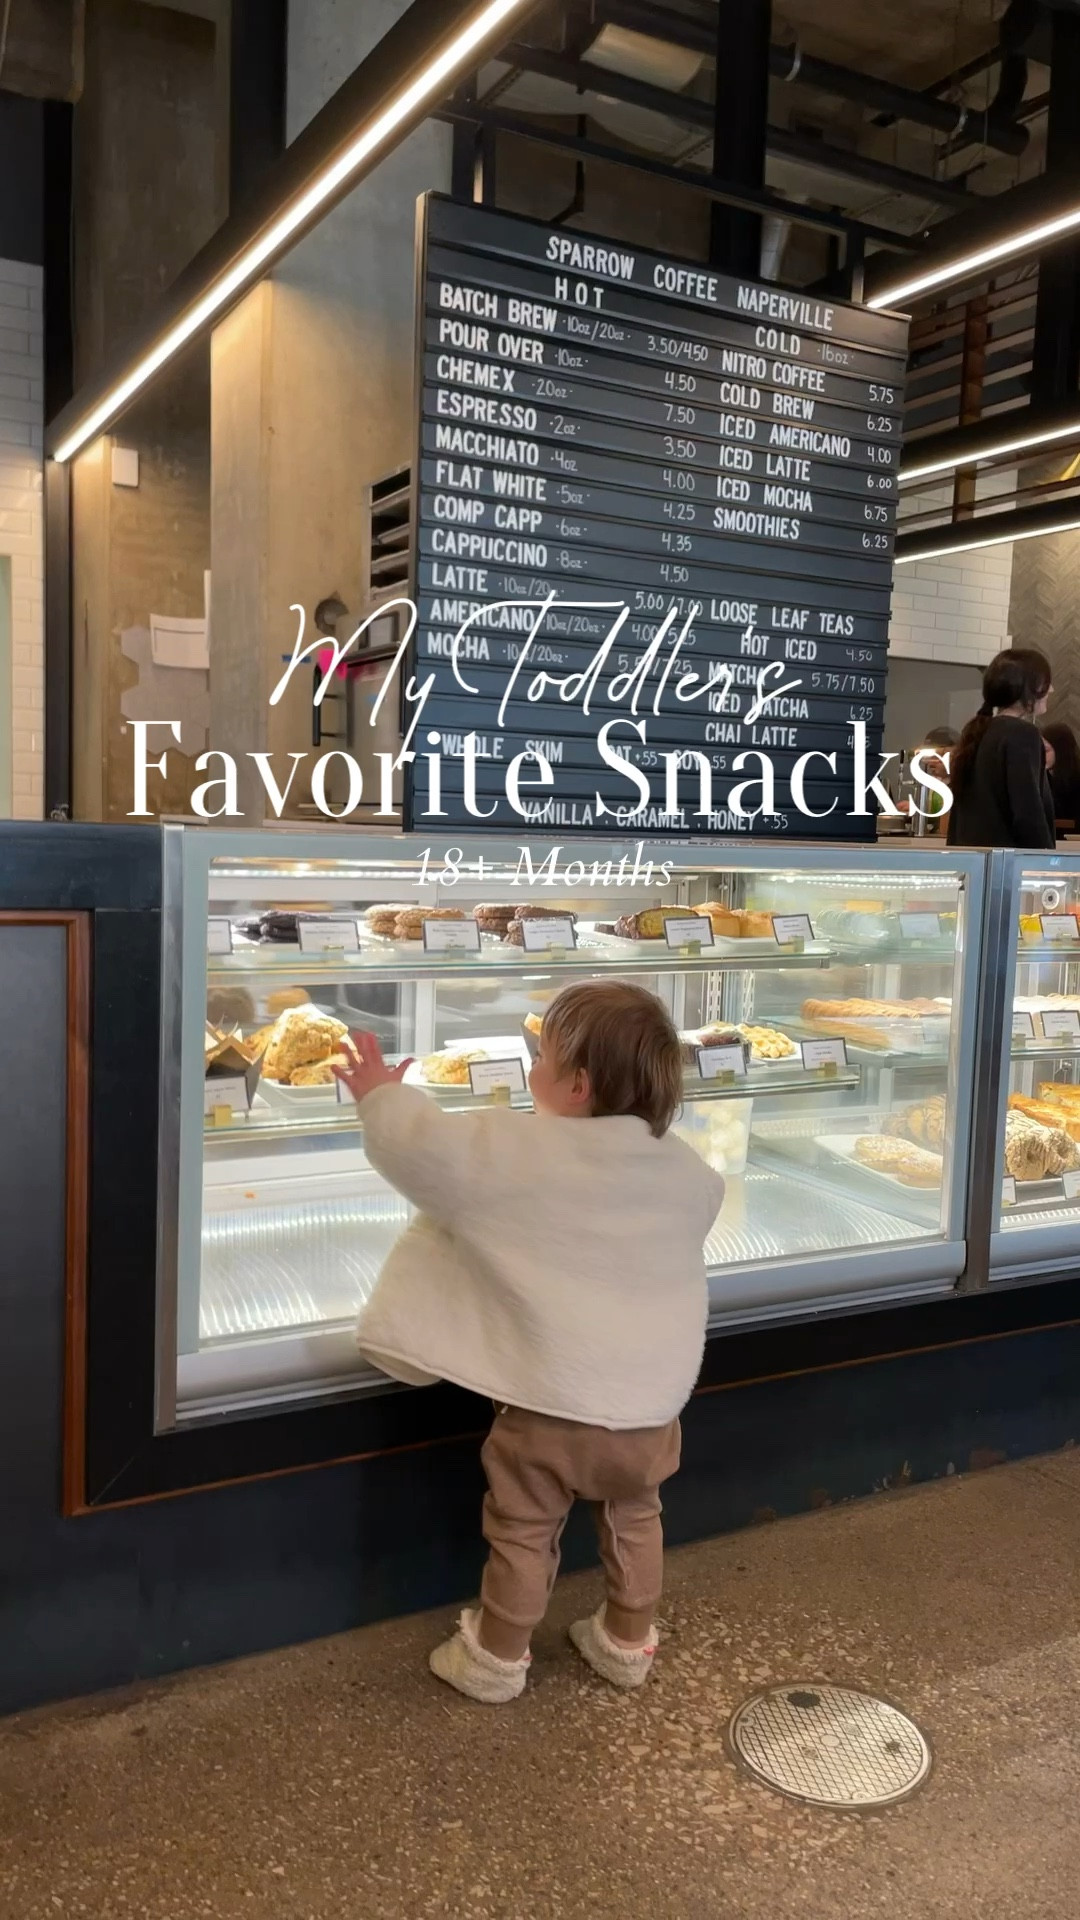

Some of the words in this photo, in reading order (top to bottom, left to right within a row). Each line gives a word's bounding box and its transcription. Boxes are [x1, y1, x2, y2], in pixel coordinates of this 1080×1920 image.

[546, 236, 635, 280] SPARROW
[653, 264, 718, 302] COFFEE
[737, 285, 834, 331] NAPERVILLE
[439, 283, 498, 319] BATCH
[508, 299, 558, 332] BREW
[439, 319, 489, 352] POUR
[498, 333, 544, 365] OVER
[664, 371, 697, 392] 4.50
[755, 326, 800, 356] COLD
[437, 355, 515, 393] CHEMEX
[663, 403, 696, 425] 7.50
[722, 350, 766, 379] NITRO
[772, 362, 826, 393] COFFEE
[869, 385, 894, 404] 5.75
[437, 389, 537, 431] ESPRESSO
[663, 435, 696, 459] 3.50
[720, 382, 761, 410] COLD
[773, 393, 815, 421] BREW
[867, 415, 893, 433] 6.25
[436, 424, 539, 466] MACCHIATO
[663, 473, 695, 491] 4.00
[719, 413, 756, 440] ICED
[769, 423, 851, 458] AMERICANO
[867, 449, 892, 465] 4.00
[719, 445, 753, 471] ICED
[766, 453, 811, 481] LATTE
[867, 474, 892, 489] 6.00
[436, 460, 483, 490] FLAT
[493, 469, 547, 501] WHITE
[663, 503, 696, 521] 4.25
[717, 476, 750, 502] ICED
[764, 484, 813, 513] MOCHA
[864, 505, 888, 522] 6.75
[433, 494, 485, 524] COMP
[494, 504, 543, 533] CAPP
[662, 532, 692, 552] 4.35
[713, 507, 800, 540] SMOOTHIES
[862, 533, 888, 549] 6.25
[432, 528, 547, 568] CAPPUCCINO
[660, 564, 689, 583] 4.50
[432, 563, 489, 592] LATTE
[430, 599, 535, 632] AMERICANO
[710, 599, 758, 625] LOOSE
[771, 606, 810, 630] LEAF
[820, 612, 854, 636] TEAS
[427, 631, 490, 661] MOCHA
[740, 633, 770, 656] HOT
[785, 638, 817, 661] ICED
[846, 649, 873, 662] 4.50
[708, 691, 741, 713] ICED
[850, 706, 874, 720] 6.25
[811, 672, 875, 694] 5.75/7.50
[524, 740, 563, 763] SKIM
[705, 722, 741, 744] CHAI
[752, 726, 798, 747] LATTE
[522, 801, 593, 826] VANILLA
[616, 806, 690, 829] CARAMEL
[707, 809, 756, 831] HONEY
